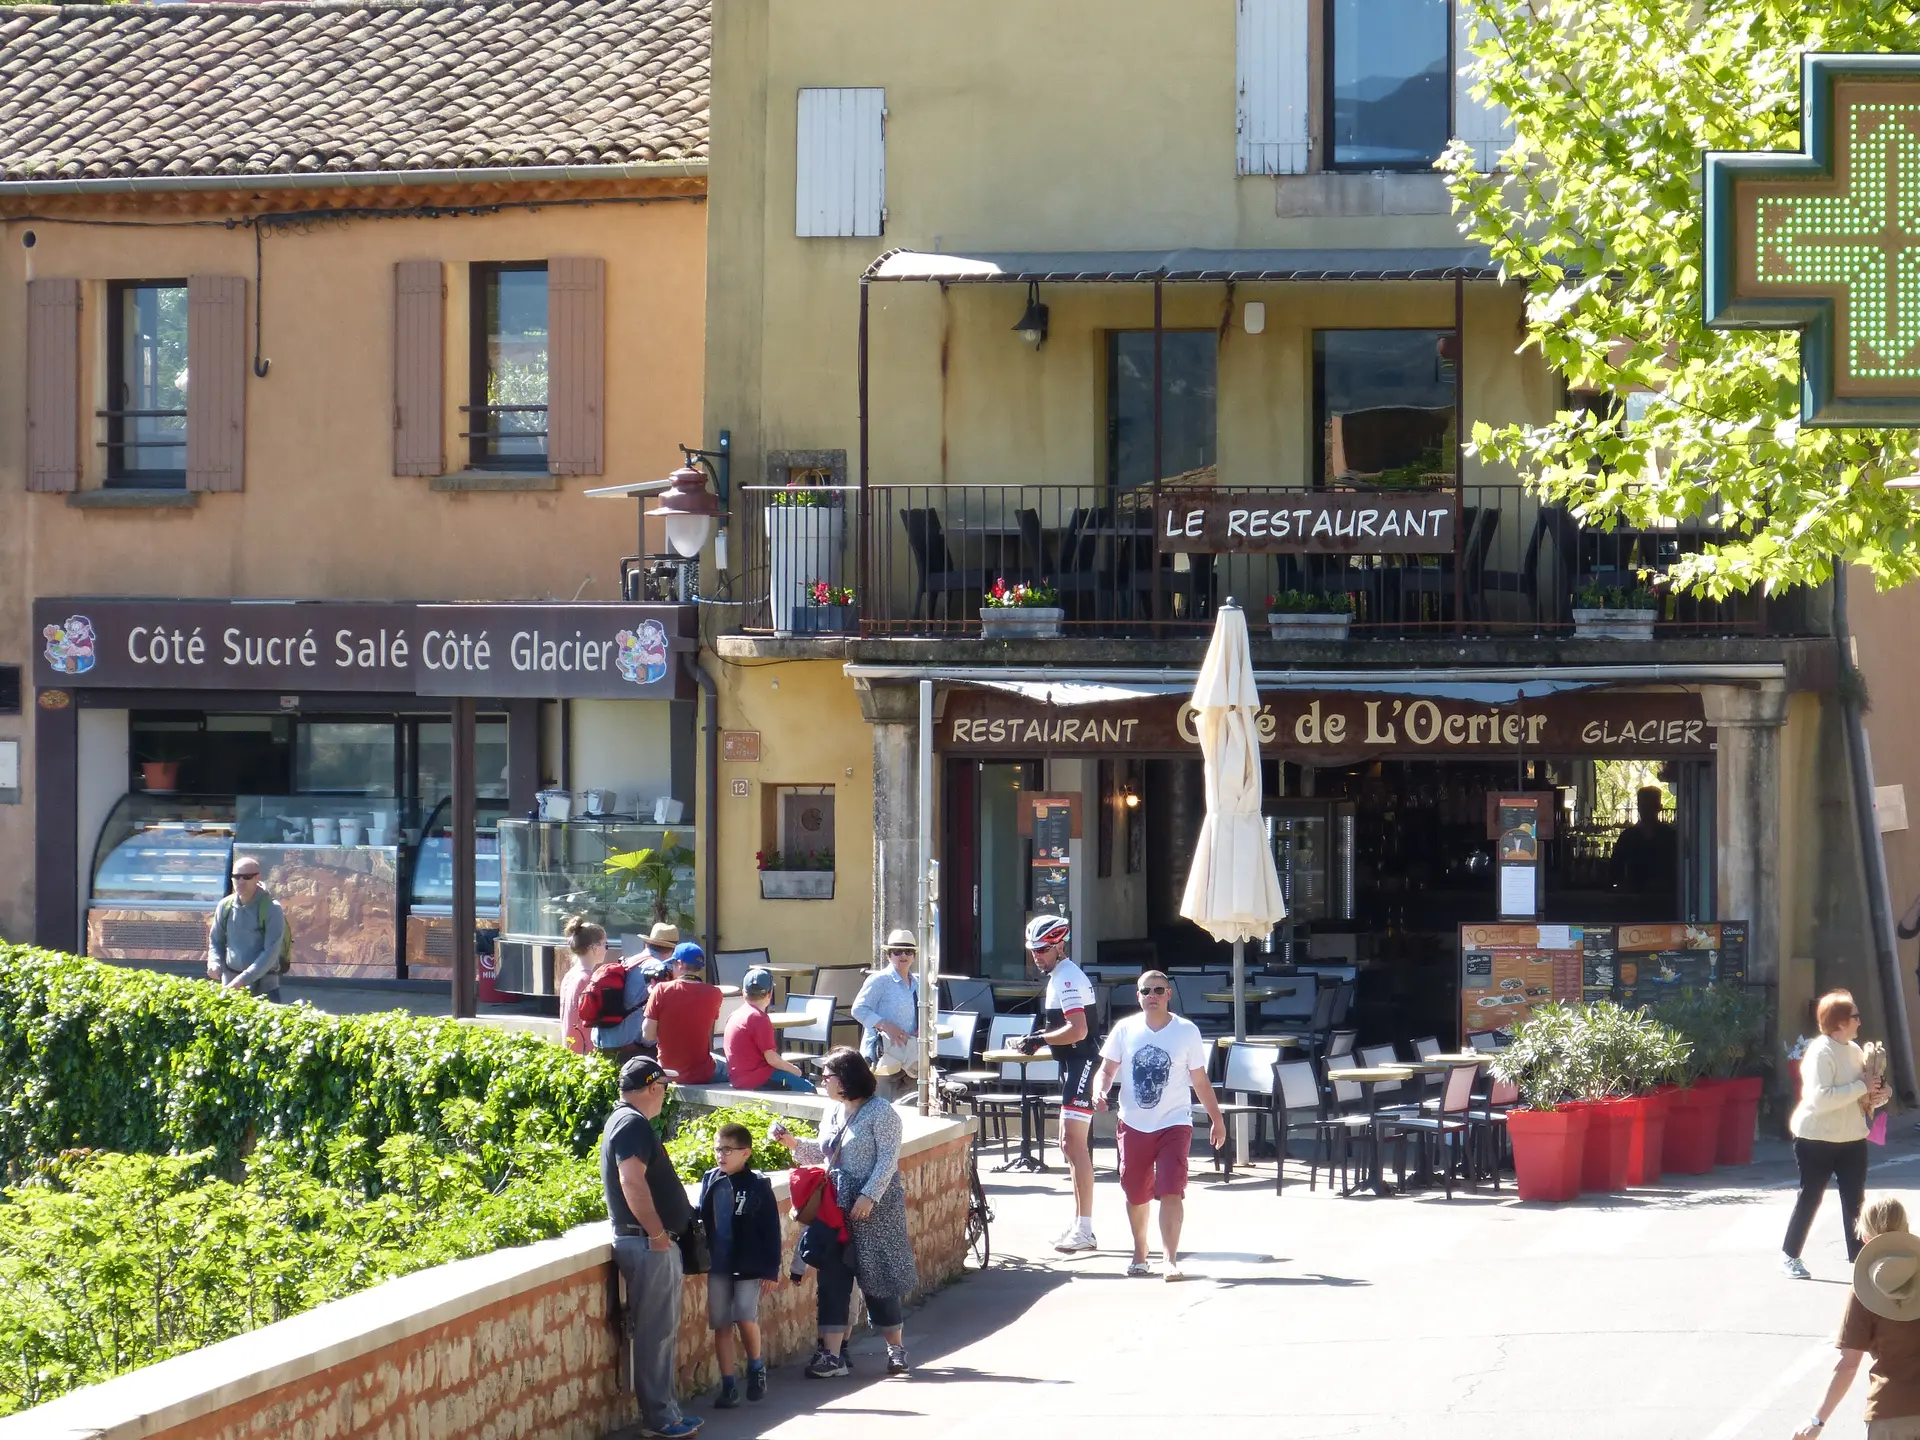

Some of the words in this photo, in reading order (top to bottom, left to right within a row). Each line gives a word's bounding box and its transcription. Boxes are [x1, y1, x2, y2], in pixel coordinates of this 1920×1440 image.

[1166, 509, 1205, 537] LE
[1227, 509, 1449, 537] RESTAURANT
[128, 626, 205, 665] Côté
[223, 628, 317, 667] Sucré
[335, 629, 409, 668] Salé
[422, 630, 491, 671] Côté
[510, 630, 613, 672] Glacier
[952, 718, 1139, 743] RESTAURANT
[1176, 700, 1277, 745] Cé
[1294, 699, 1346, 744] de
[1363, 700, 1548, 745] L'Ocrier
[1581, 719, 1704, 744] GLACIER
[733, 782, 746, 794] 12
[1076, 1059, 1093, 1095] TREK
